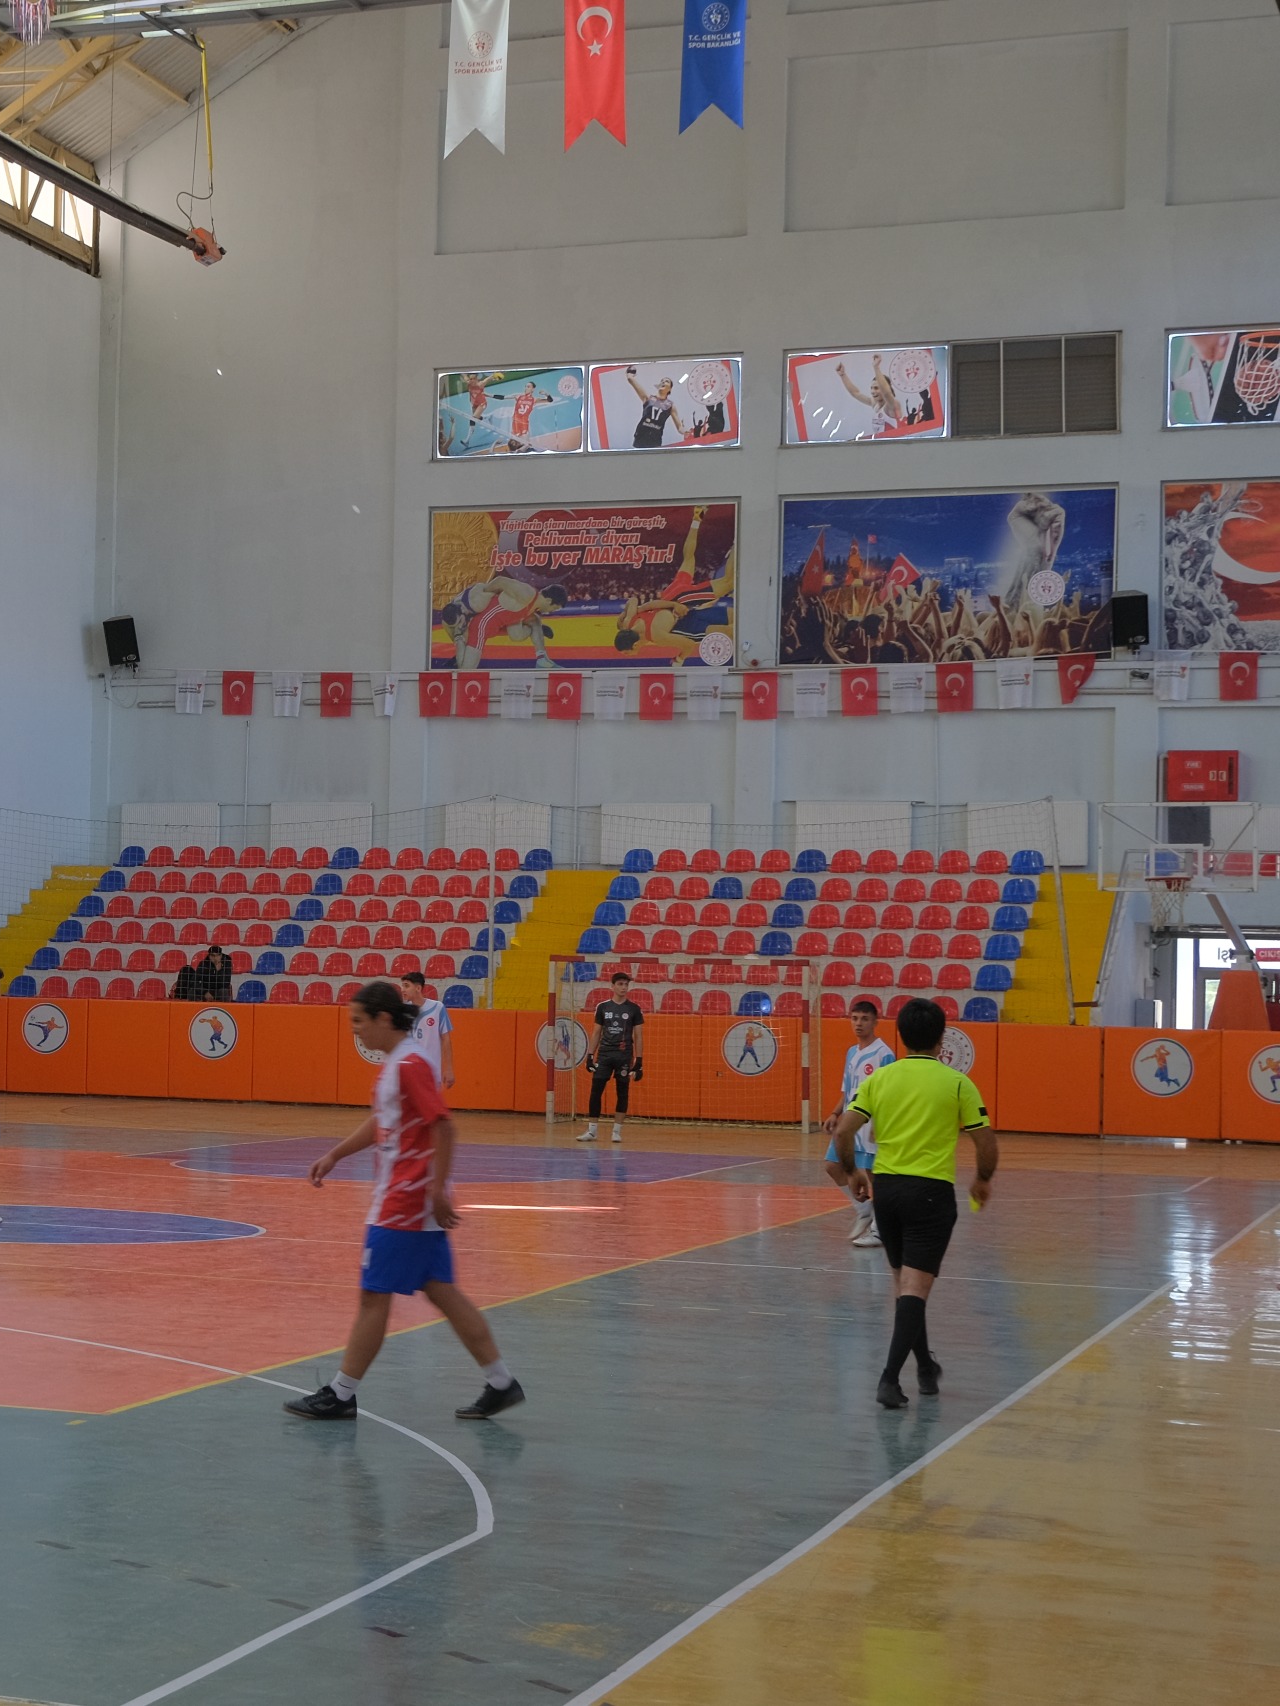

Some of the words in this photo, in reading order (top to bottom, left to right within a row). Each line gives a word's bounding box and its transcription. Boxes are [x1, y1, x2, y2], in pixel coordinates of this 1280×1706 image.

[610, 516, 626, 529] bir
[523, 530, 599, 548] Pehlivanlar
[600, 529, 640, 547] diyarı
[489, 545, 523, 572] İşte
[524, 546, 549, 567] bu
[549, 550, 581, 570] yer
[581, 543, 676, 569] MARAŞ'tır!
